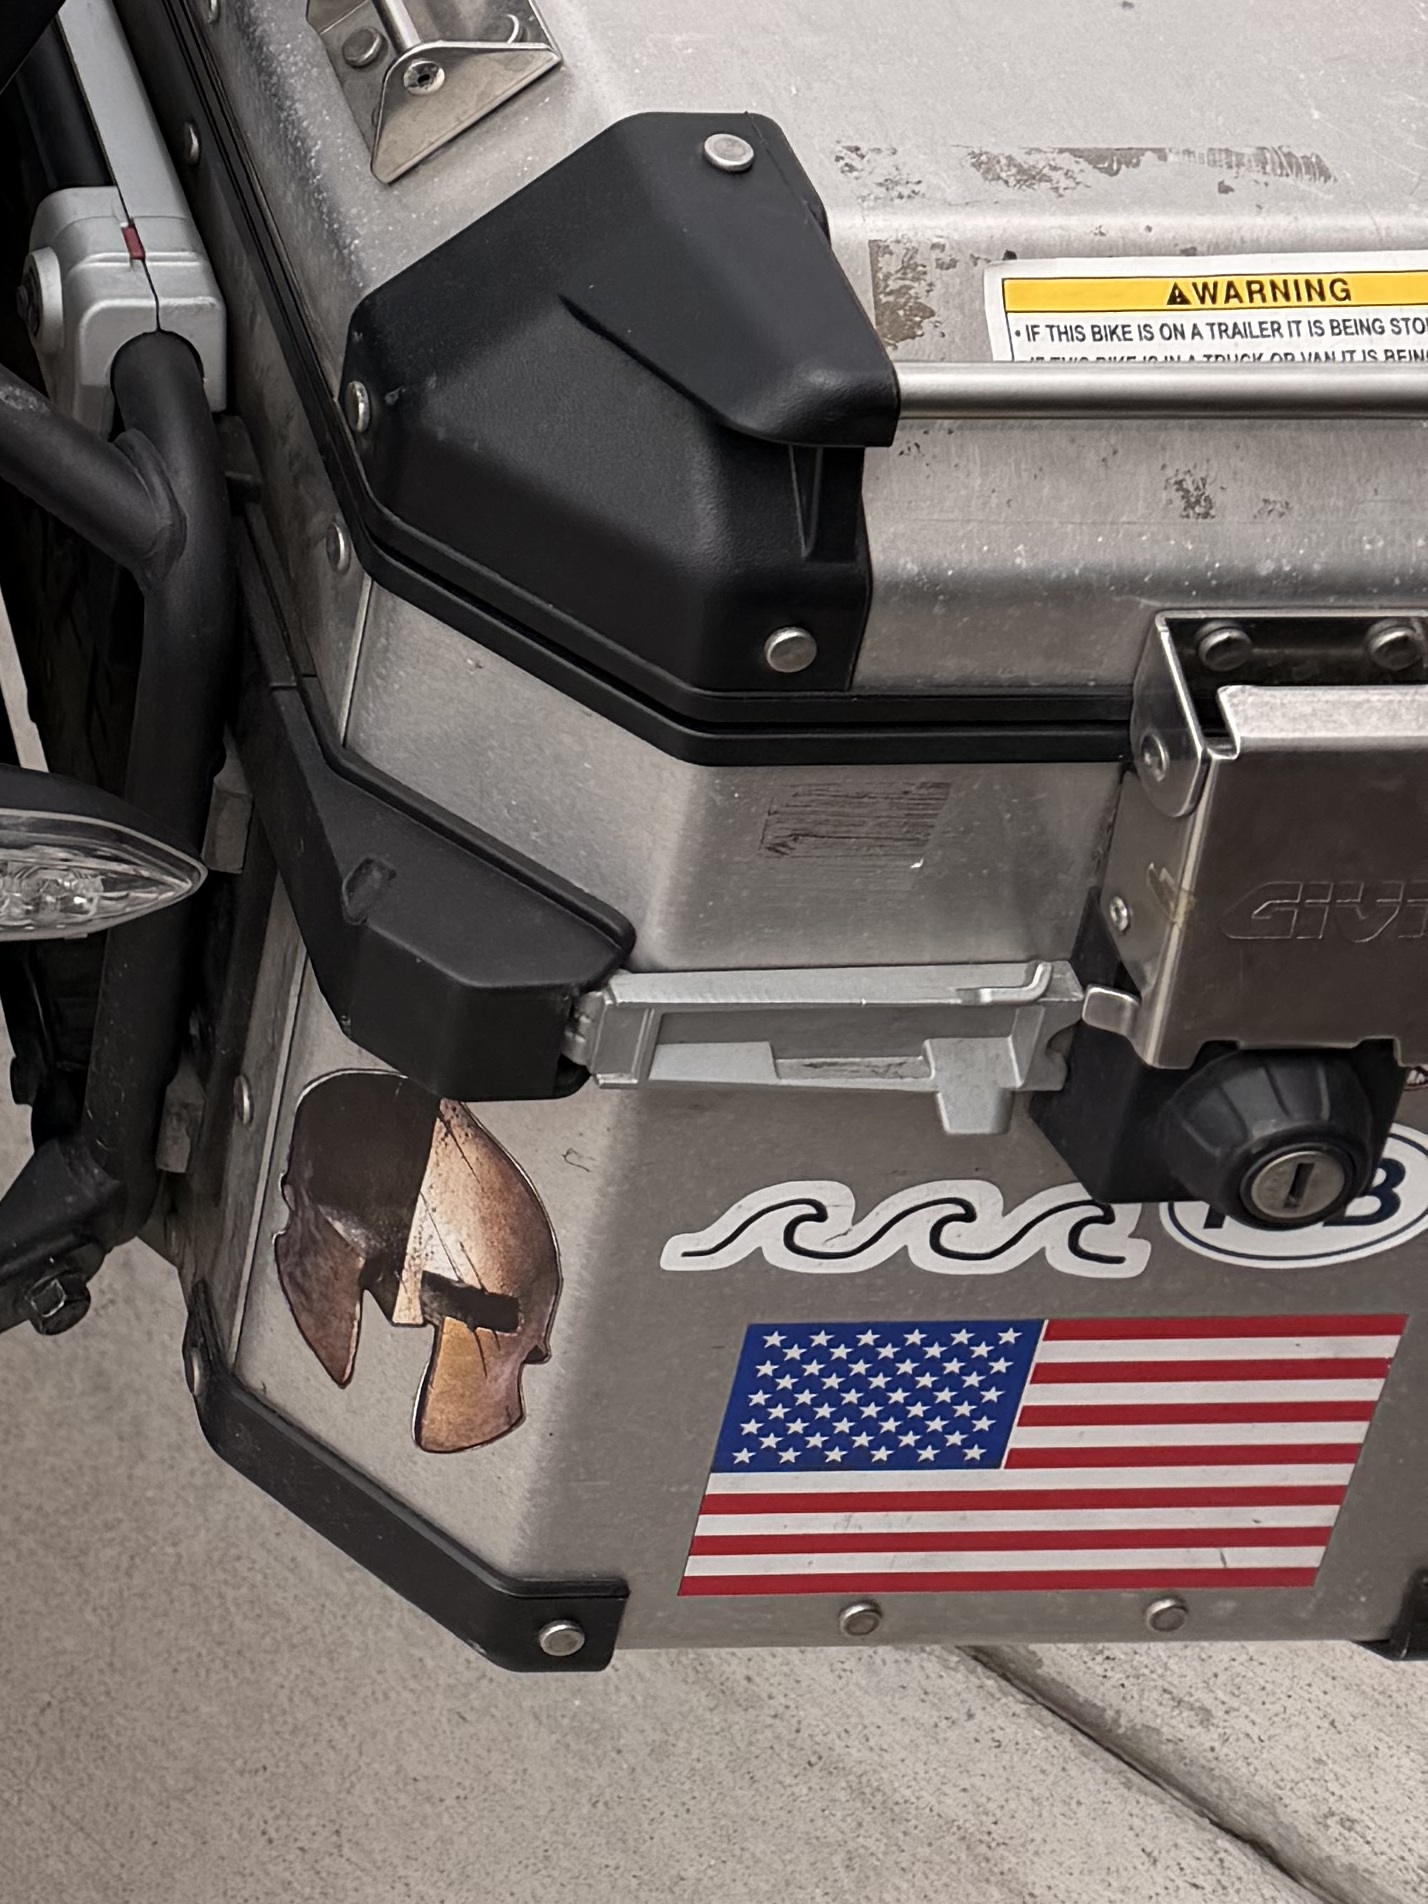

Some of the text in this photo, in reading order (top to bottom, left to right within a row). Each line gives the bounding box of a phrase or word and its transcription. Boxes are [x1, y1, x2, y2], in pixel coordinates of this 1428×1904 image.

[1191, 277, 1352, 306] WARNING
[1025, 324, 1040, 343] IF
[1045, 324, 1087, 343] THIS
[1090, 323, 1134, 343] BIKE
[1137, 323, 1155, 343] IS
[1158, 322, 1186, 342] ON
[1190, 322, 1204, 341] A
[1206, 320, 1284, 340] TRAILER
[1287, 319, 1303, 338] IT
[1307, 319, 1326, 338] IS
[1329, 317, 1386, 337] BEING
